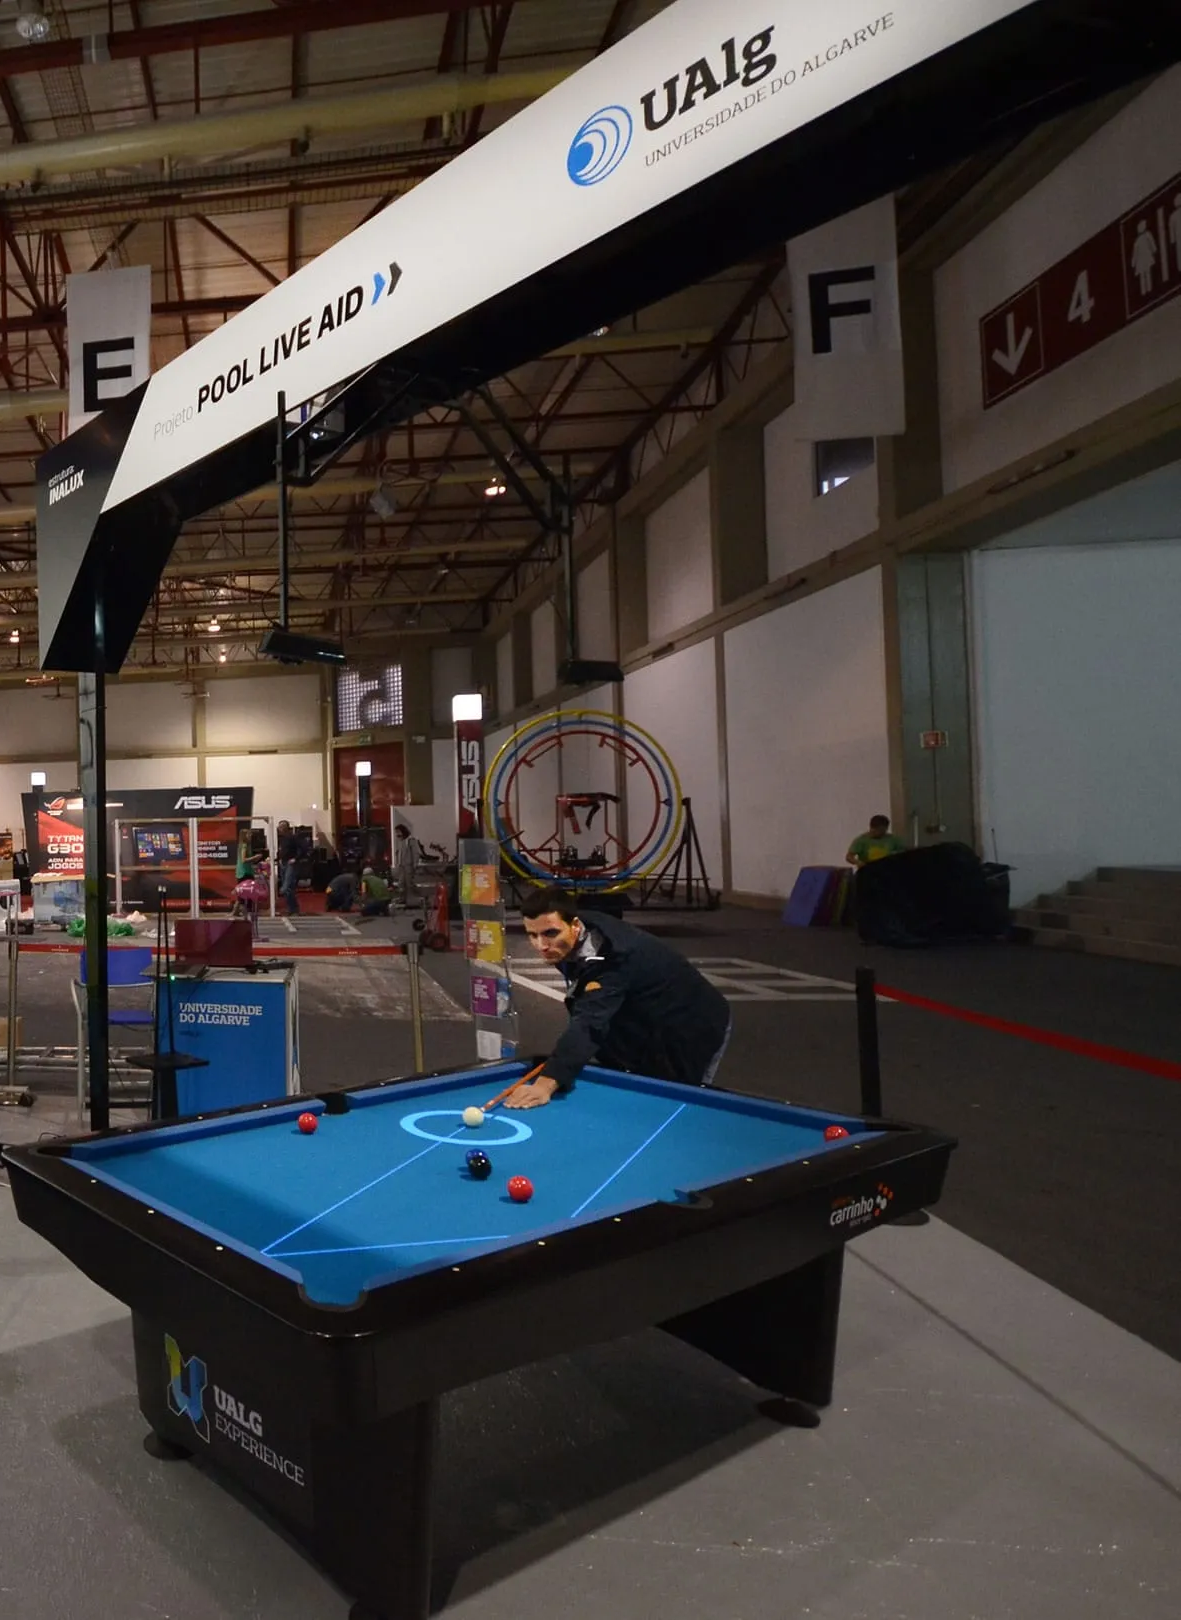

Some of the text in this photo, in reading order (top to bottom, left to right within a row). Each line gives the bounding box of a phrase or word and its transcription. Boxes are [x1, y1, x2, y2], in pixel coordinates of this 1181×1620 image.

[640, 24, 777, 132] UAlg
[645, 12, 895, 168] UNIVERSIDADE DO ALGARVE
[807, 265, 876, 355] F
[1067, 269, 1095, 324] 4
[82, 336, 135, 413] E
[152, 285, 365, 442] Projeto POOL LIVE AID
[49, 469, 84, 506] INALUX
[173, 795, 231, 810] ASUS
[461, 740, 481, 815] ASUS
[179, 1002, 263, 1016] UNIVERSIDADE
[179, 1013, 250, 1026] DO ALGARVE
[830, 1196, 874, 1226] carrinho
[213, 1384, 263, 1437] UALG
[215, 1411, 305, 1487] EXPERIENCE
